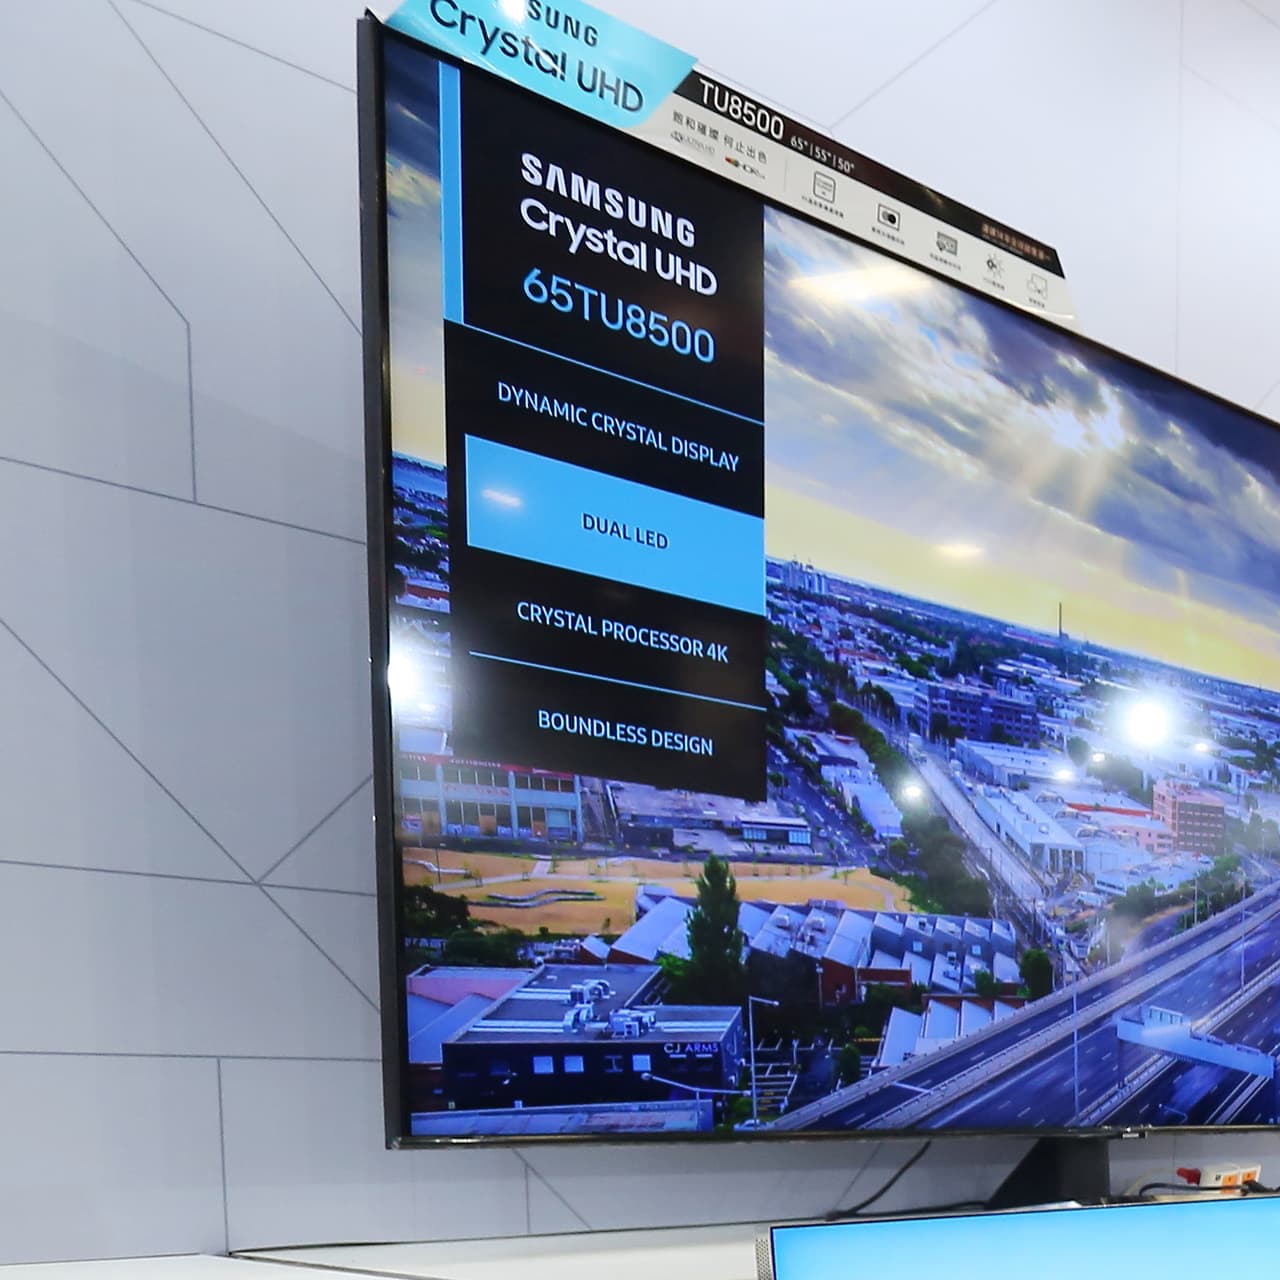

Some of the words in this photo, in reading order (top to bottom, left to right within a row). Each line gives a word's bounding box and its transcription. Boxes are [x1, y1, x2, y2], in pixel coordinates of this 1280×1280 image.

[429, 0, 566, 81] Crystal
[577, 60, 644, 112] UHD
[528, 0, 599, 47] SUNG
[699, 78, 784, 140] TU8500
[521, 153, 695, 248] SAMSUNG
[520, 198, 648, 272] Crystal
[655, 248, 718, 296] UHD
[523, 267, 715, 363] 65TU8500
[498, 381, 588, 427] DYNAMIC
[591, 411, 667, 451] CRYSTAL
[671, 436, 739, 472] DISPLAY
[582, 512, 632, 541] DUAL
[636, 530, 669, 550] LED
[517, 601, 597, 636] CRYSTAL
[601, 619, 704, 657] PROCESSOR
[706, 641, 729, 663] 4K
[538, 709, 647, 745] BOUNDLESS
[651, 728, 713, 756] DESIGN
